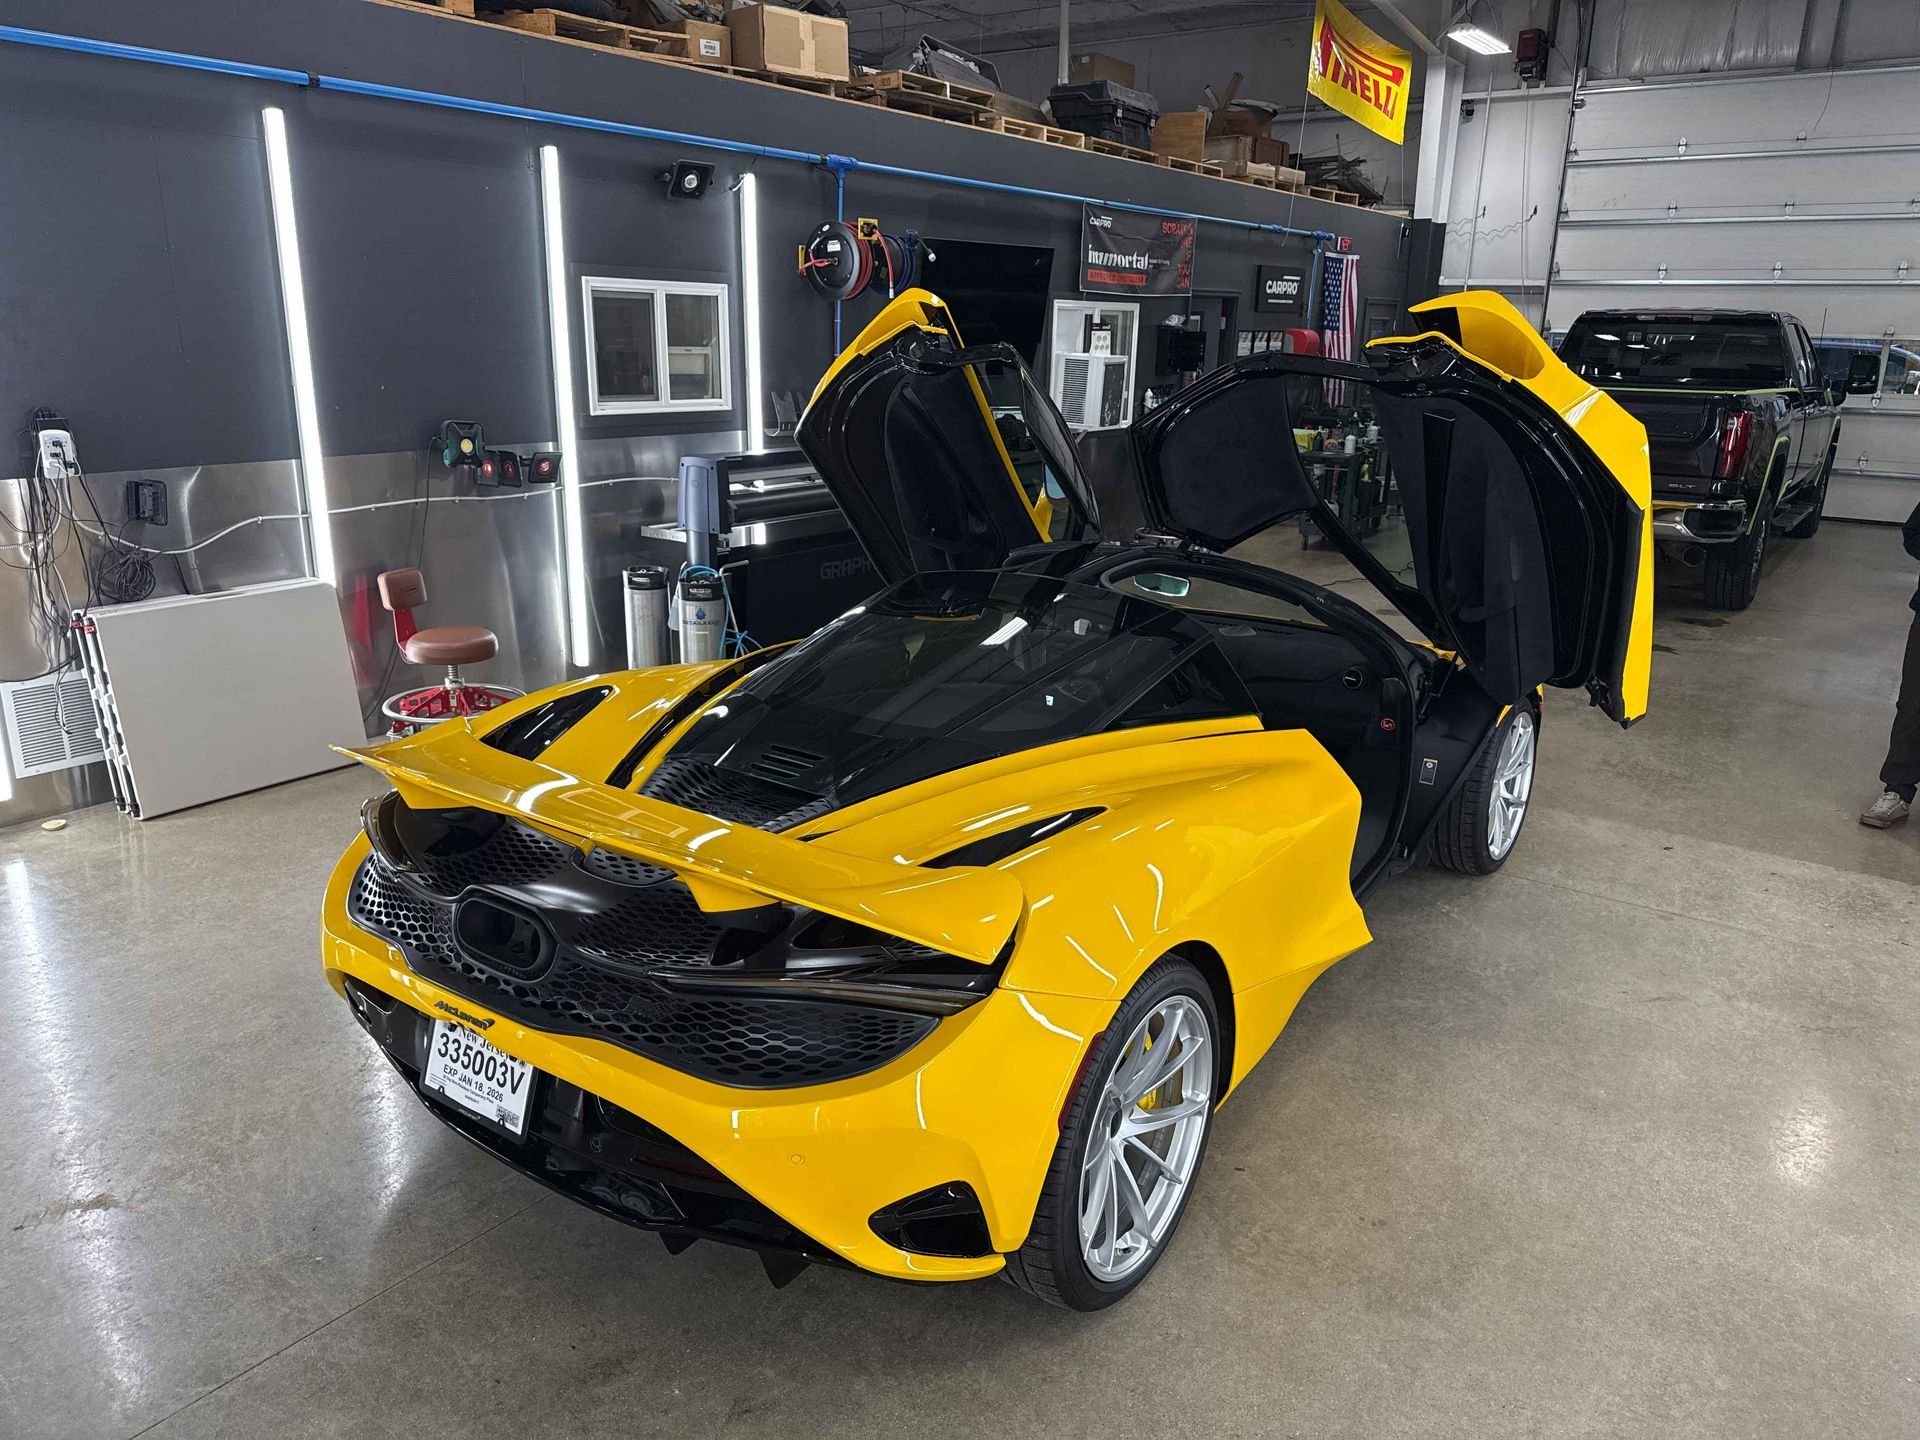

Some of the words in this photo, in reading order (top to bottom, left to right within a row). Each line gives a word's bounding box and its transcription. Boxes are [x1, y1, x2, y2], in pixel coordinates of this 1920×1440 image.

[1319, 14, 1405, 121] PIRELLI
[1088, 244, 1149, 270] immortal
[1265, 279, 1299, 295] CARPRO
[434, 1000, 489, 1031] McLaren
[458, 1025, 479, 1045] New
[480, 1037, 511, 1063] Jersey
[437, 1032, 526, 1095] 335003V
[443, 1064, 458, 1077] EXP
[458, 1073, 473, 1087] JAN
[474, 1081, 485, 1095] 18,
[486, 1087, 504, 1103] 2026
